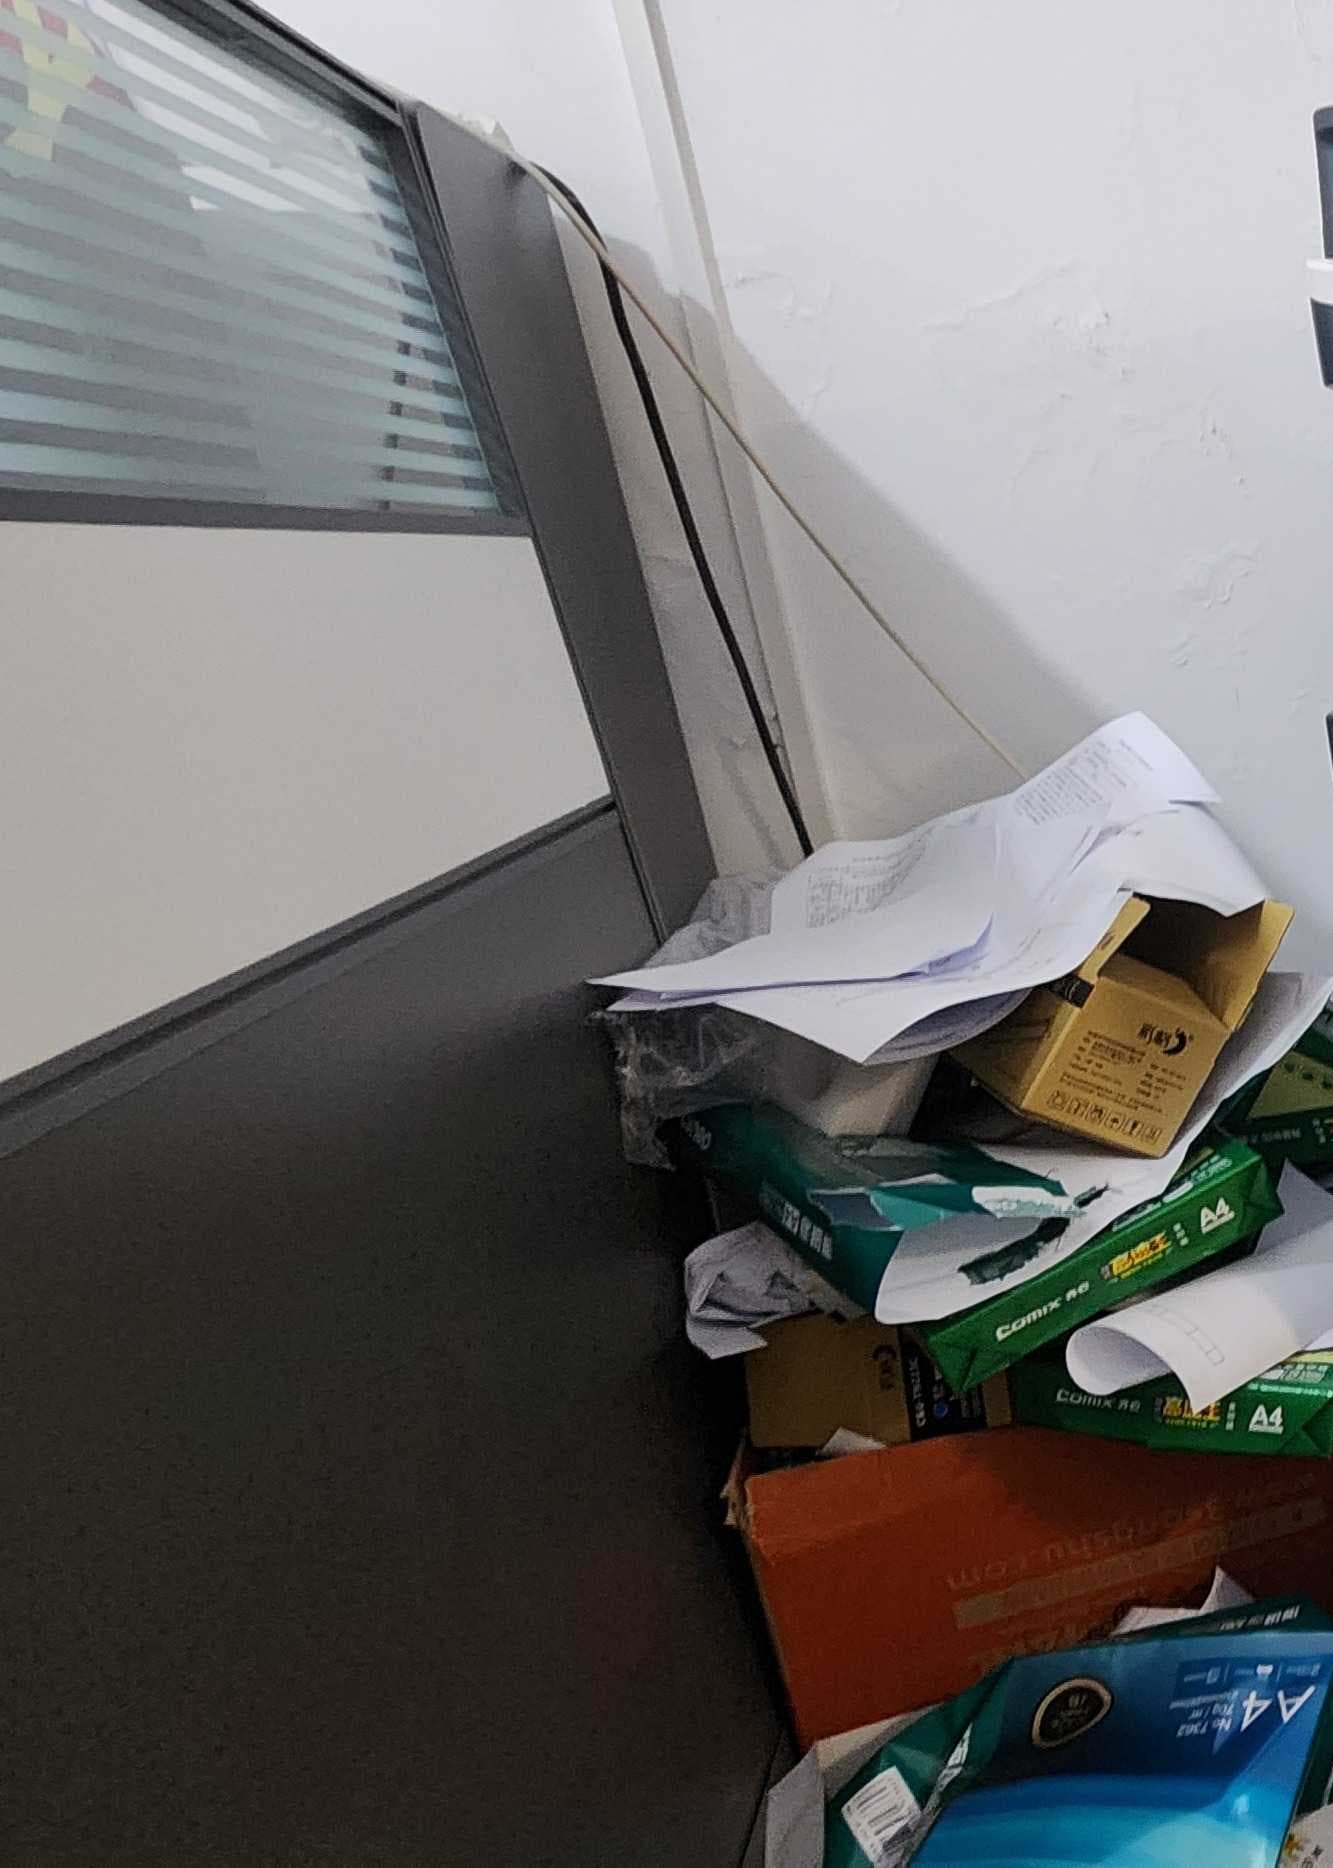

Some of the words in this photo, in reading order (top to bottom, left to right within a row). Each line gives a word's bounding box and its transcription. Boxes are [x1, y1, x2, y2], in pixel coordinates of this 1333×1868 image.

[1200, 1196, 1236, 1232] A4
[1248, 1403, 1285, 1429] A4
[1241, 1684, 1316, 1733] A4
